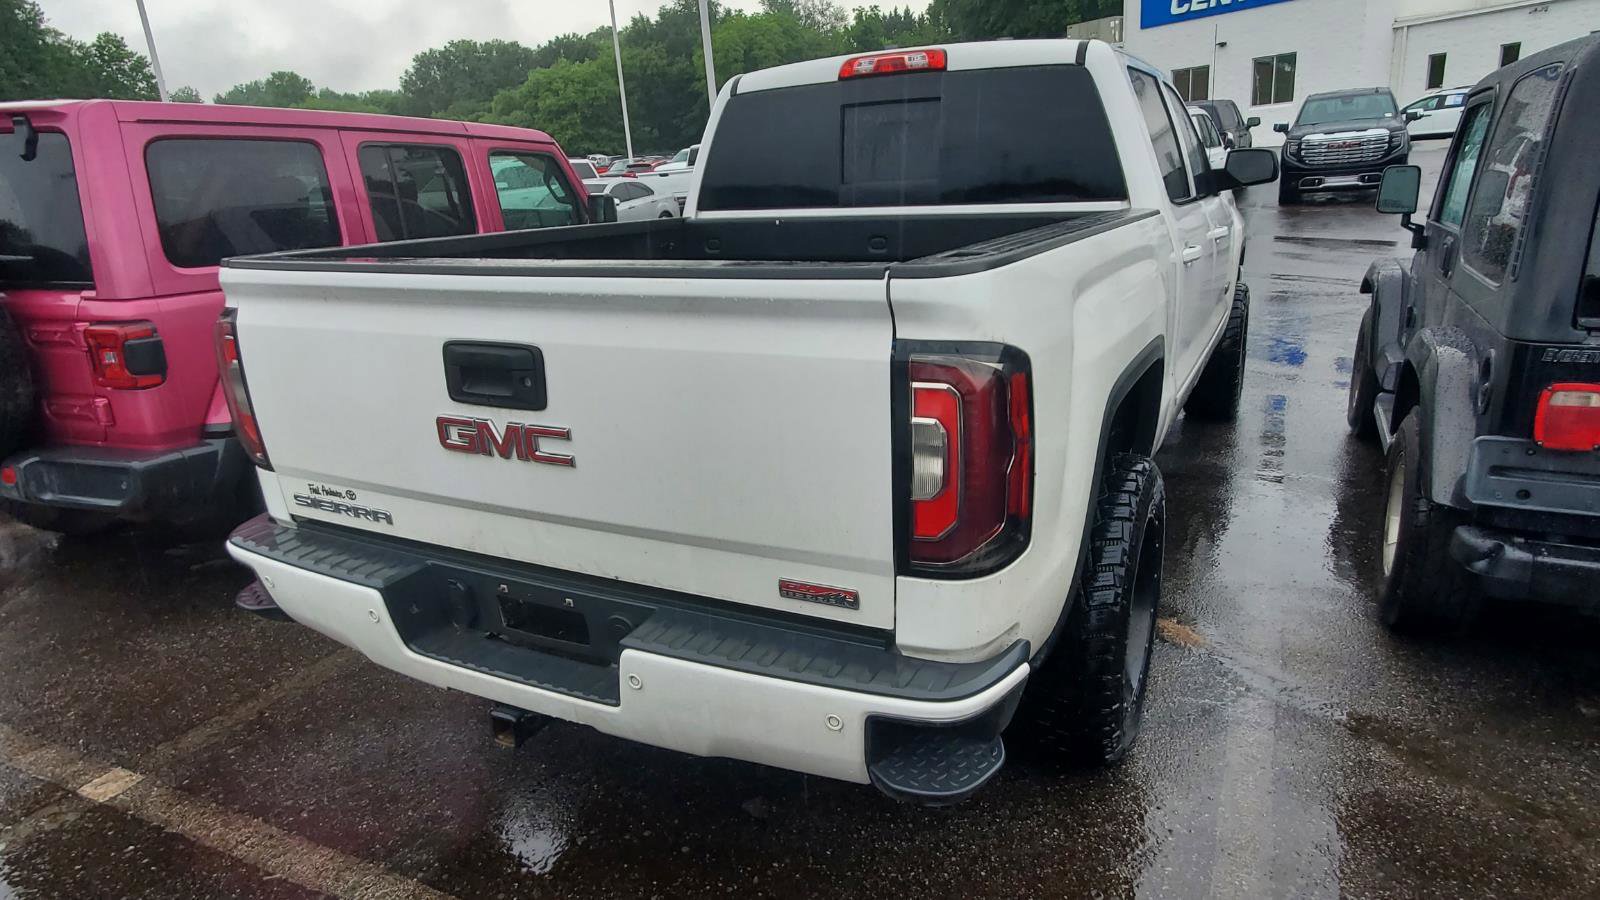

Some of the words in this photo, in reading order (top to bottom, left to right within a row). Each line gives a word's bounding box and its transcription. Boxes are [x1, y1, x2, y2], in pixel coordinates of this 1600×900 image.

[1170, 0, 1246, 15] CE
[435, 413, 577, 468] GMC
[293, 492, 393, 526] SIERRA
